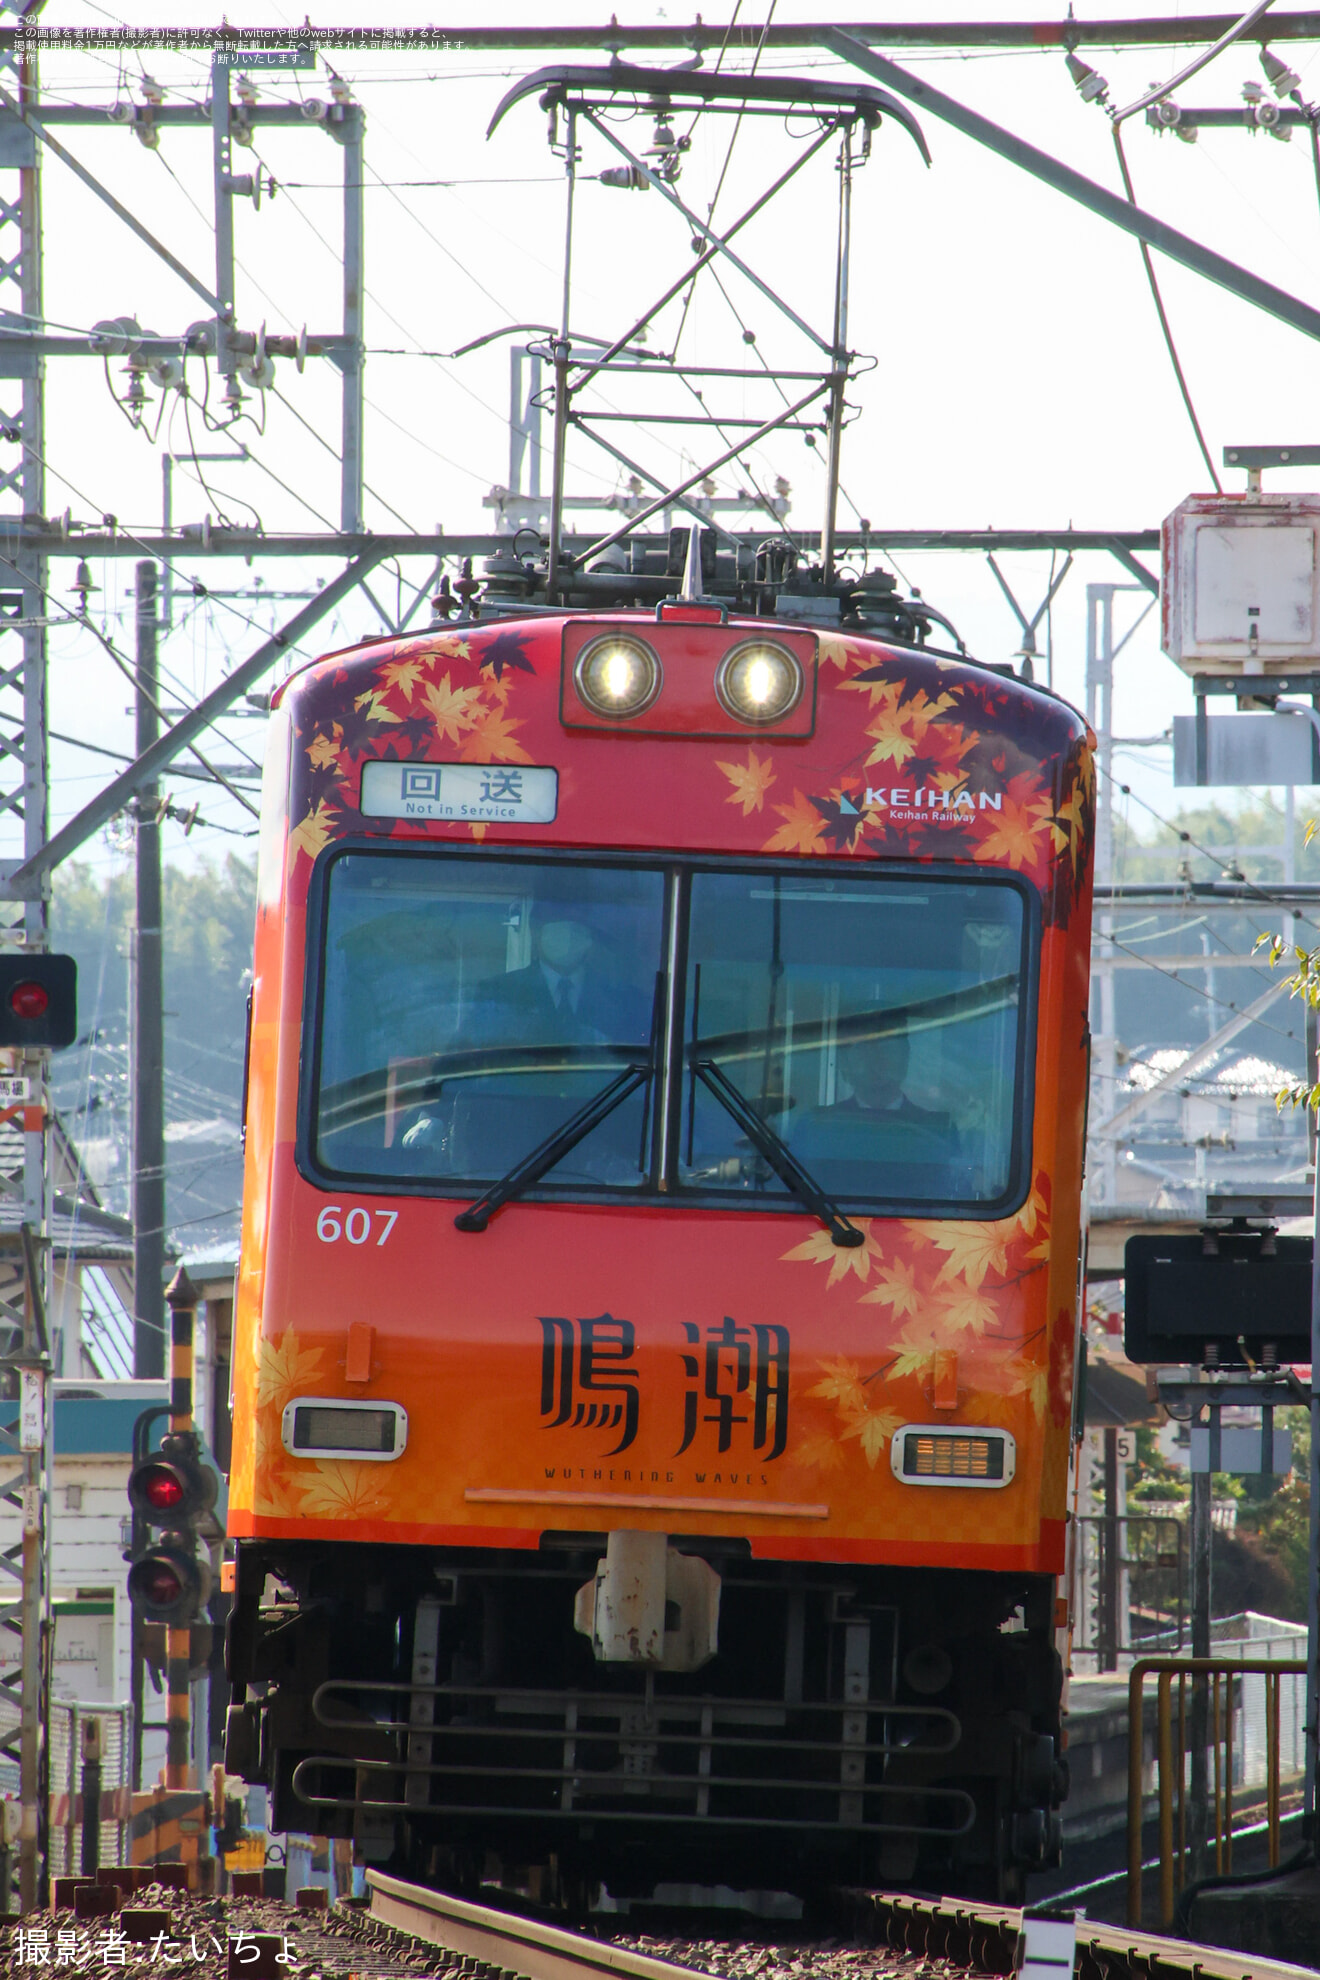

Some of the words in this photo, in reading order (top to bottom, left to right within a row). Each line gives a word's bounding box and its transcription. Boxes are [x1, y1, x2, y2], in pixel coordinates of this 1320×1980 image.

[401, 767, 523, 804] 回送
[865, 786, 1002, 811] KEIHAN
[406, 802, 432, 814] Not
[439, 803, 453, 815] in
[460, 804, 516, 817] Service
[889, 809, 929, 821] Keihan
[931, 811, 976, 824] Railway
[316, 1205, 399, 1246] 607
[1117, 1437, 1130, 1458] 5
[544, 1467, 675, 1484] WUTHERING
[695, 1472, 768, 1486] WAVES
